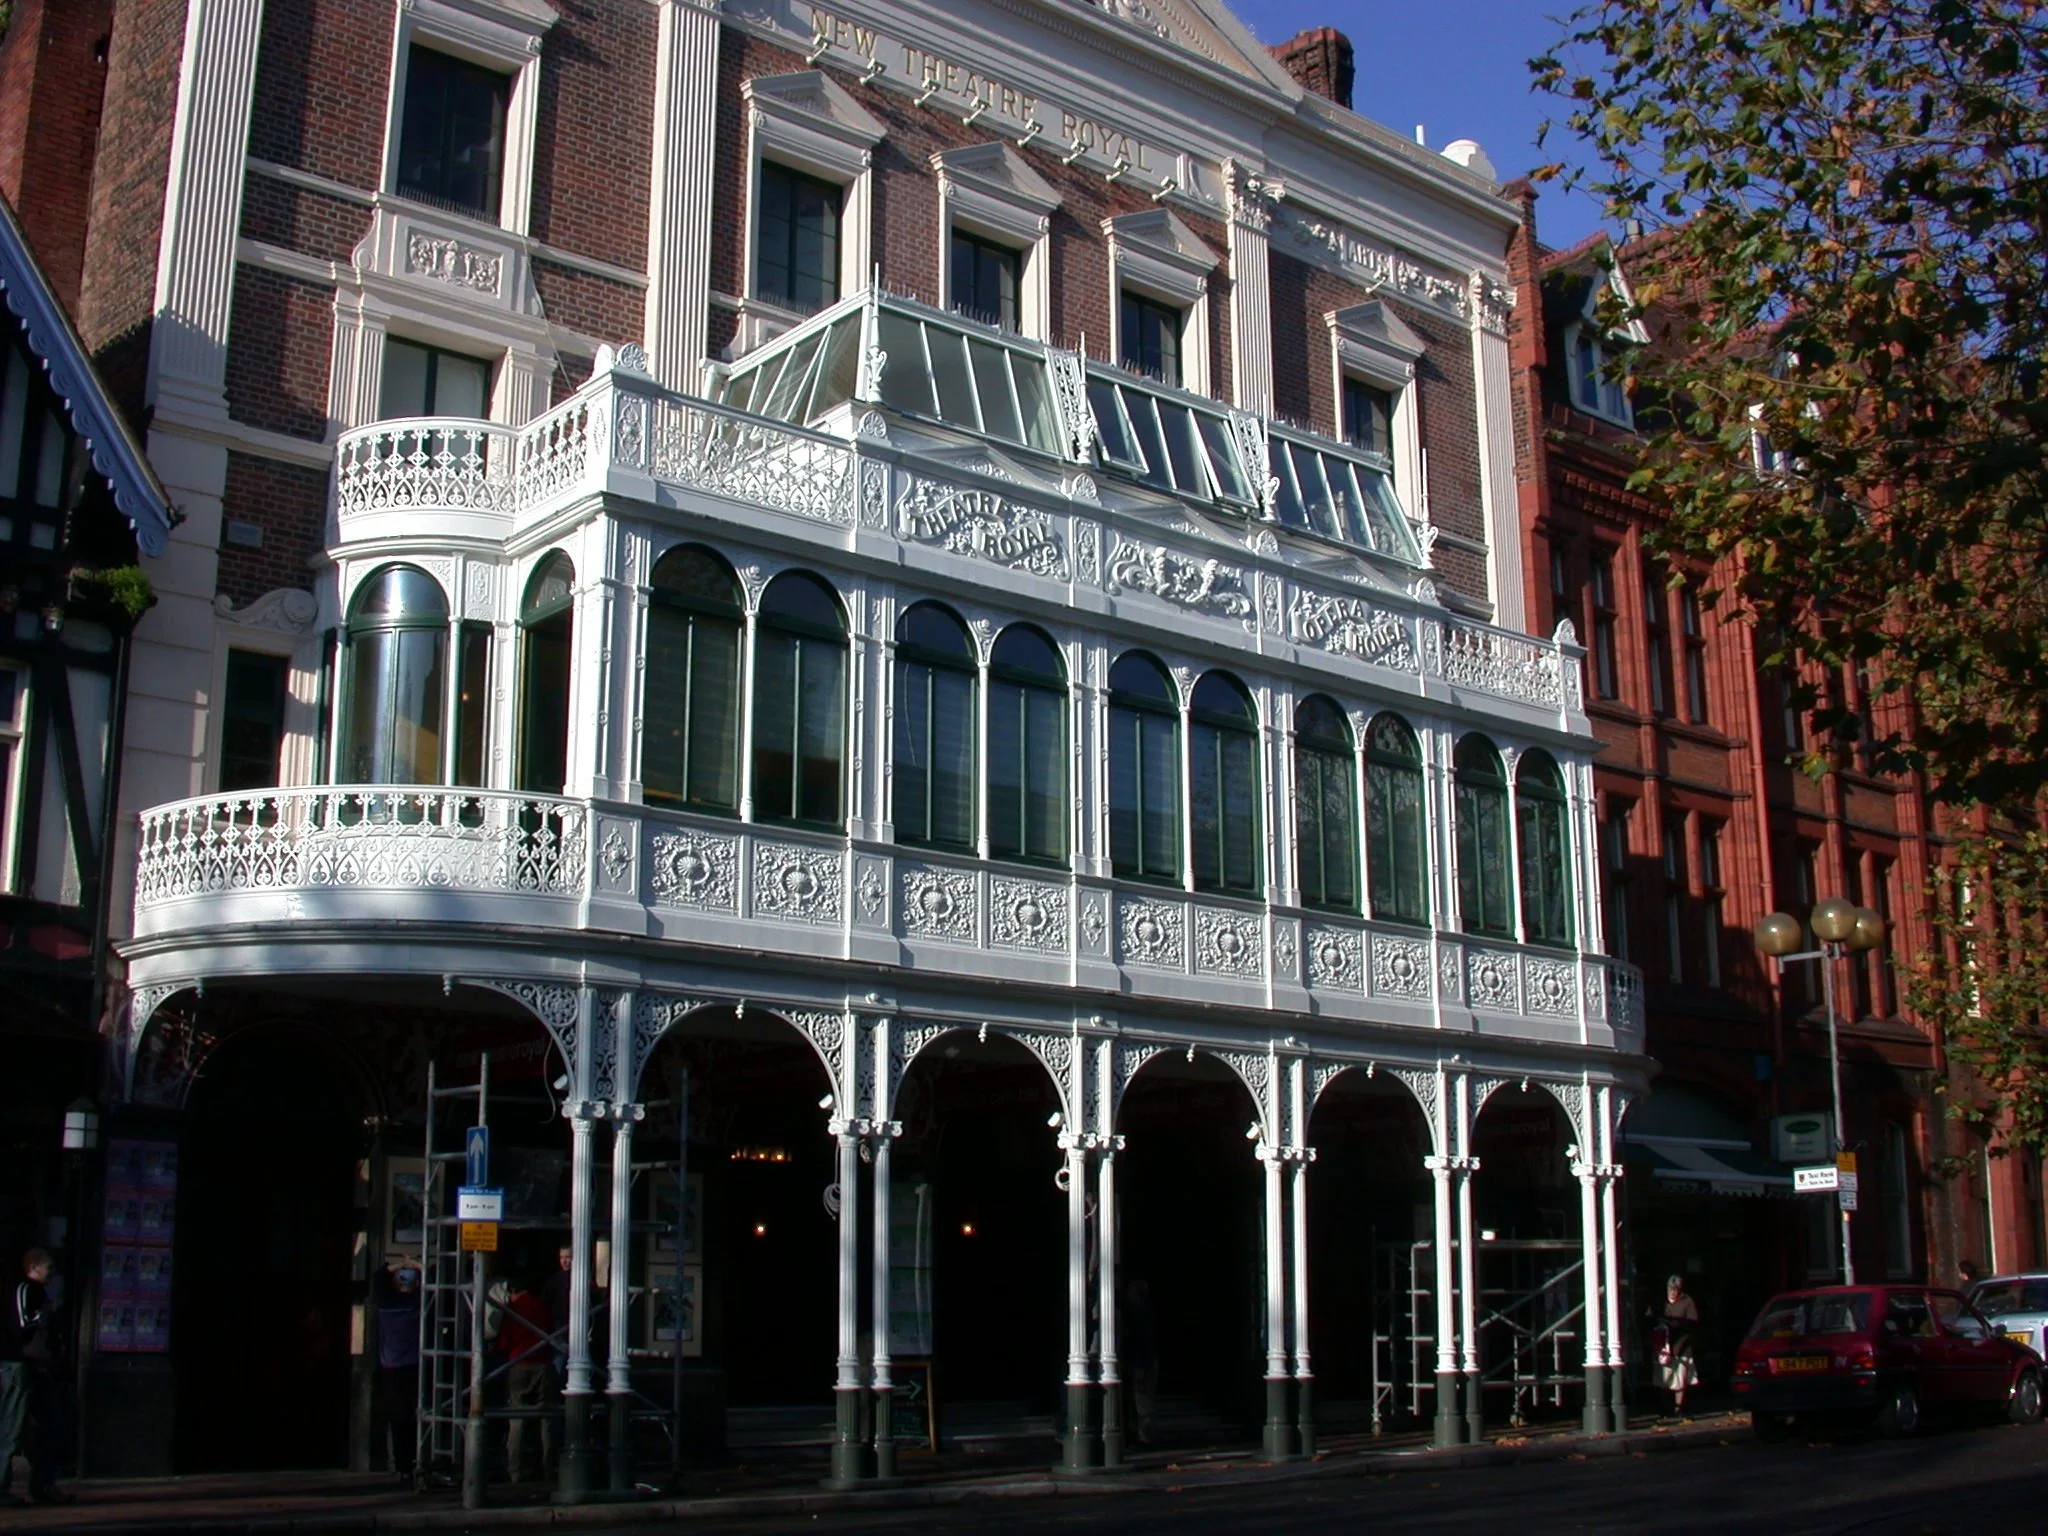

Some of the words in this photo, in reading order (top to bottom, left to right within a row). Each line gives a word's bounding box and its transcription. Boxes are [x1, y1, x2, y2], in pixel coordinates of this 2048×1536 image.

[811, 7, 878, 59] NEW
[901, 43, 1038, 124] THEATRE
[1061, 109, 1154, 173] ROYAL
[906, 490, 1008, 536] THEATRE
[980, 520, 1049, 558] ROYAL
[1302, 599, 1364, 641] OPERA
[1352, 621, 1406, 655] HOUSE
